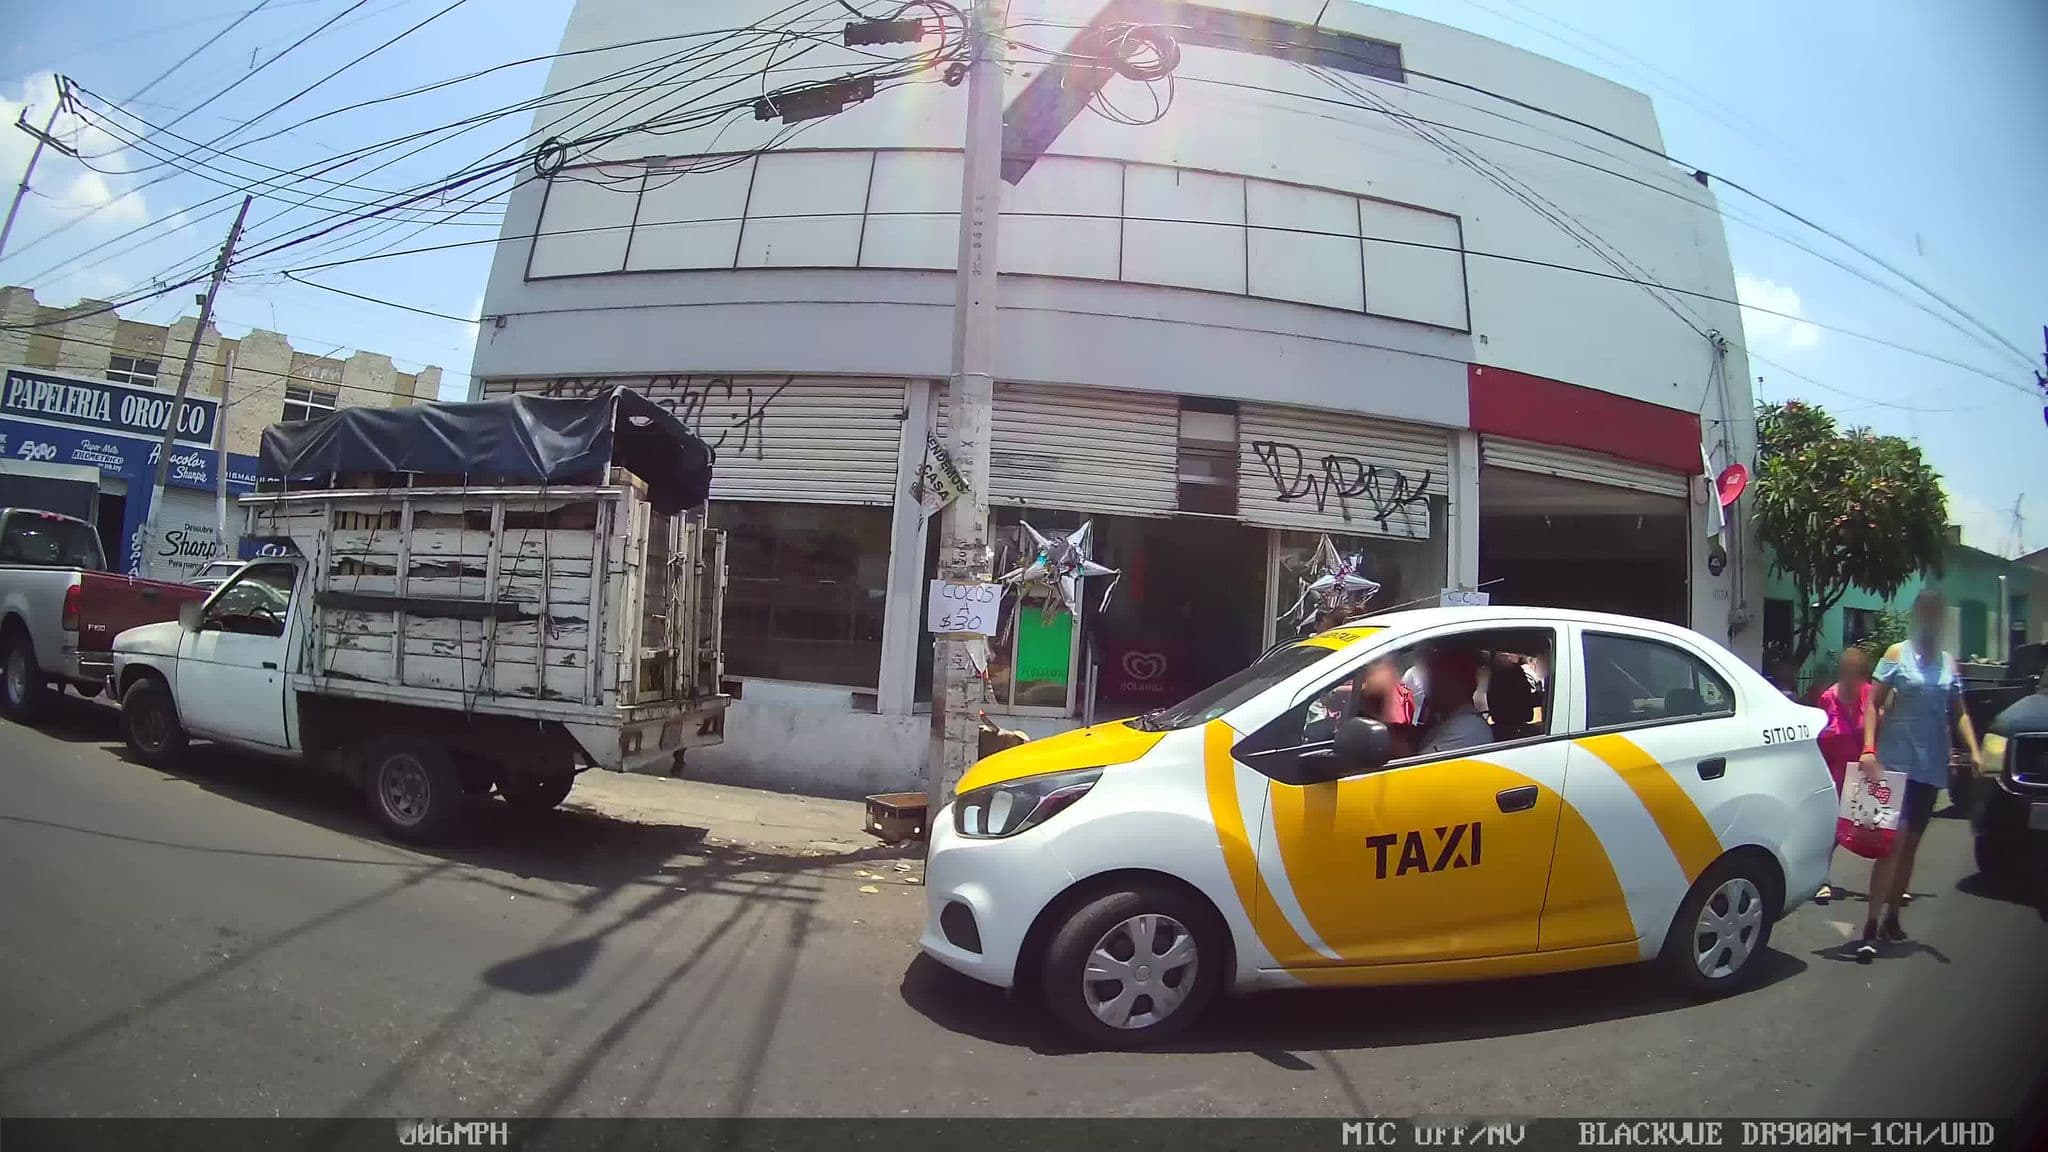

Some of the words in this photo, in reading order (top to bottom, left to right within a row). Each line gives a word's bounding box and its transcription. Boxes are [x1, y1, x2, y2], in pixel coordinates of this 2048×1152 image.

[7, 377, 111, 422] PAPELERIA
[121, 395, 205, 434] OROZCO
[924, 464, 950, 501] CASA
[942, 583, 994, 603] COCOS
[957, 602, 970, 614] A
[939, 615, 982, 631] $30
[1763, 727, 1796, 744] SITIO
[1798, 725, 1810, 738] 70
[1366, 822, 1481, 879] TAXI
